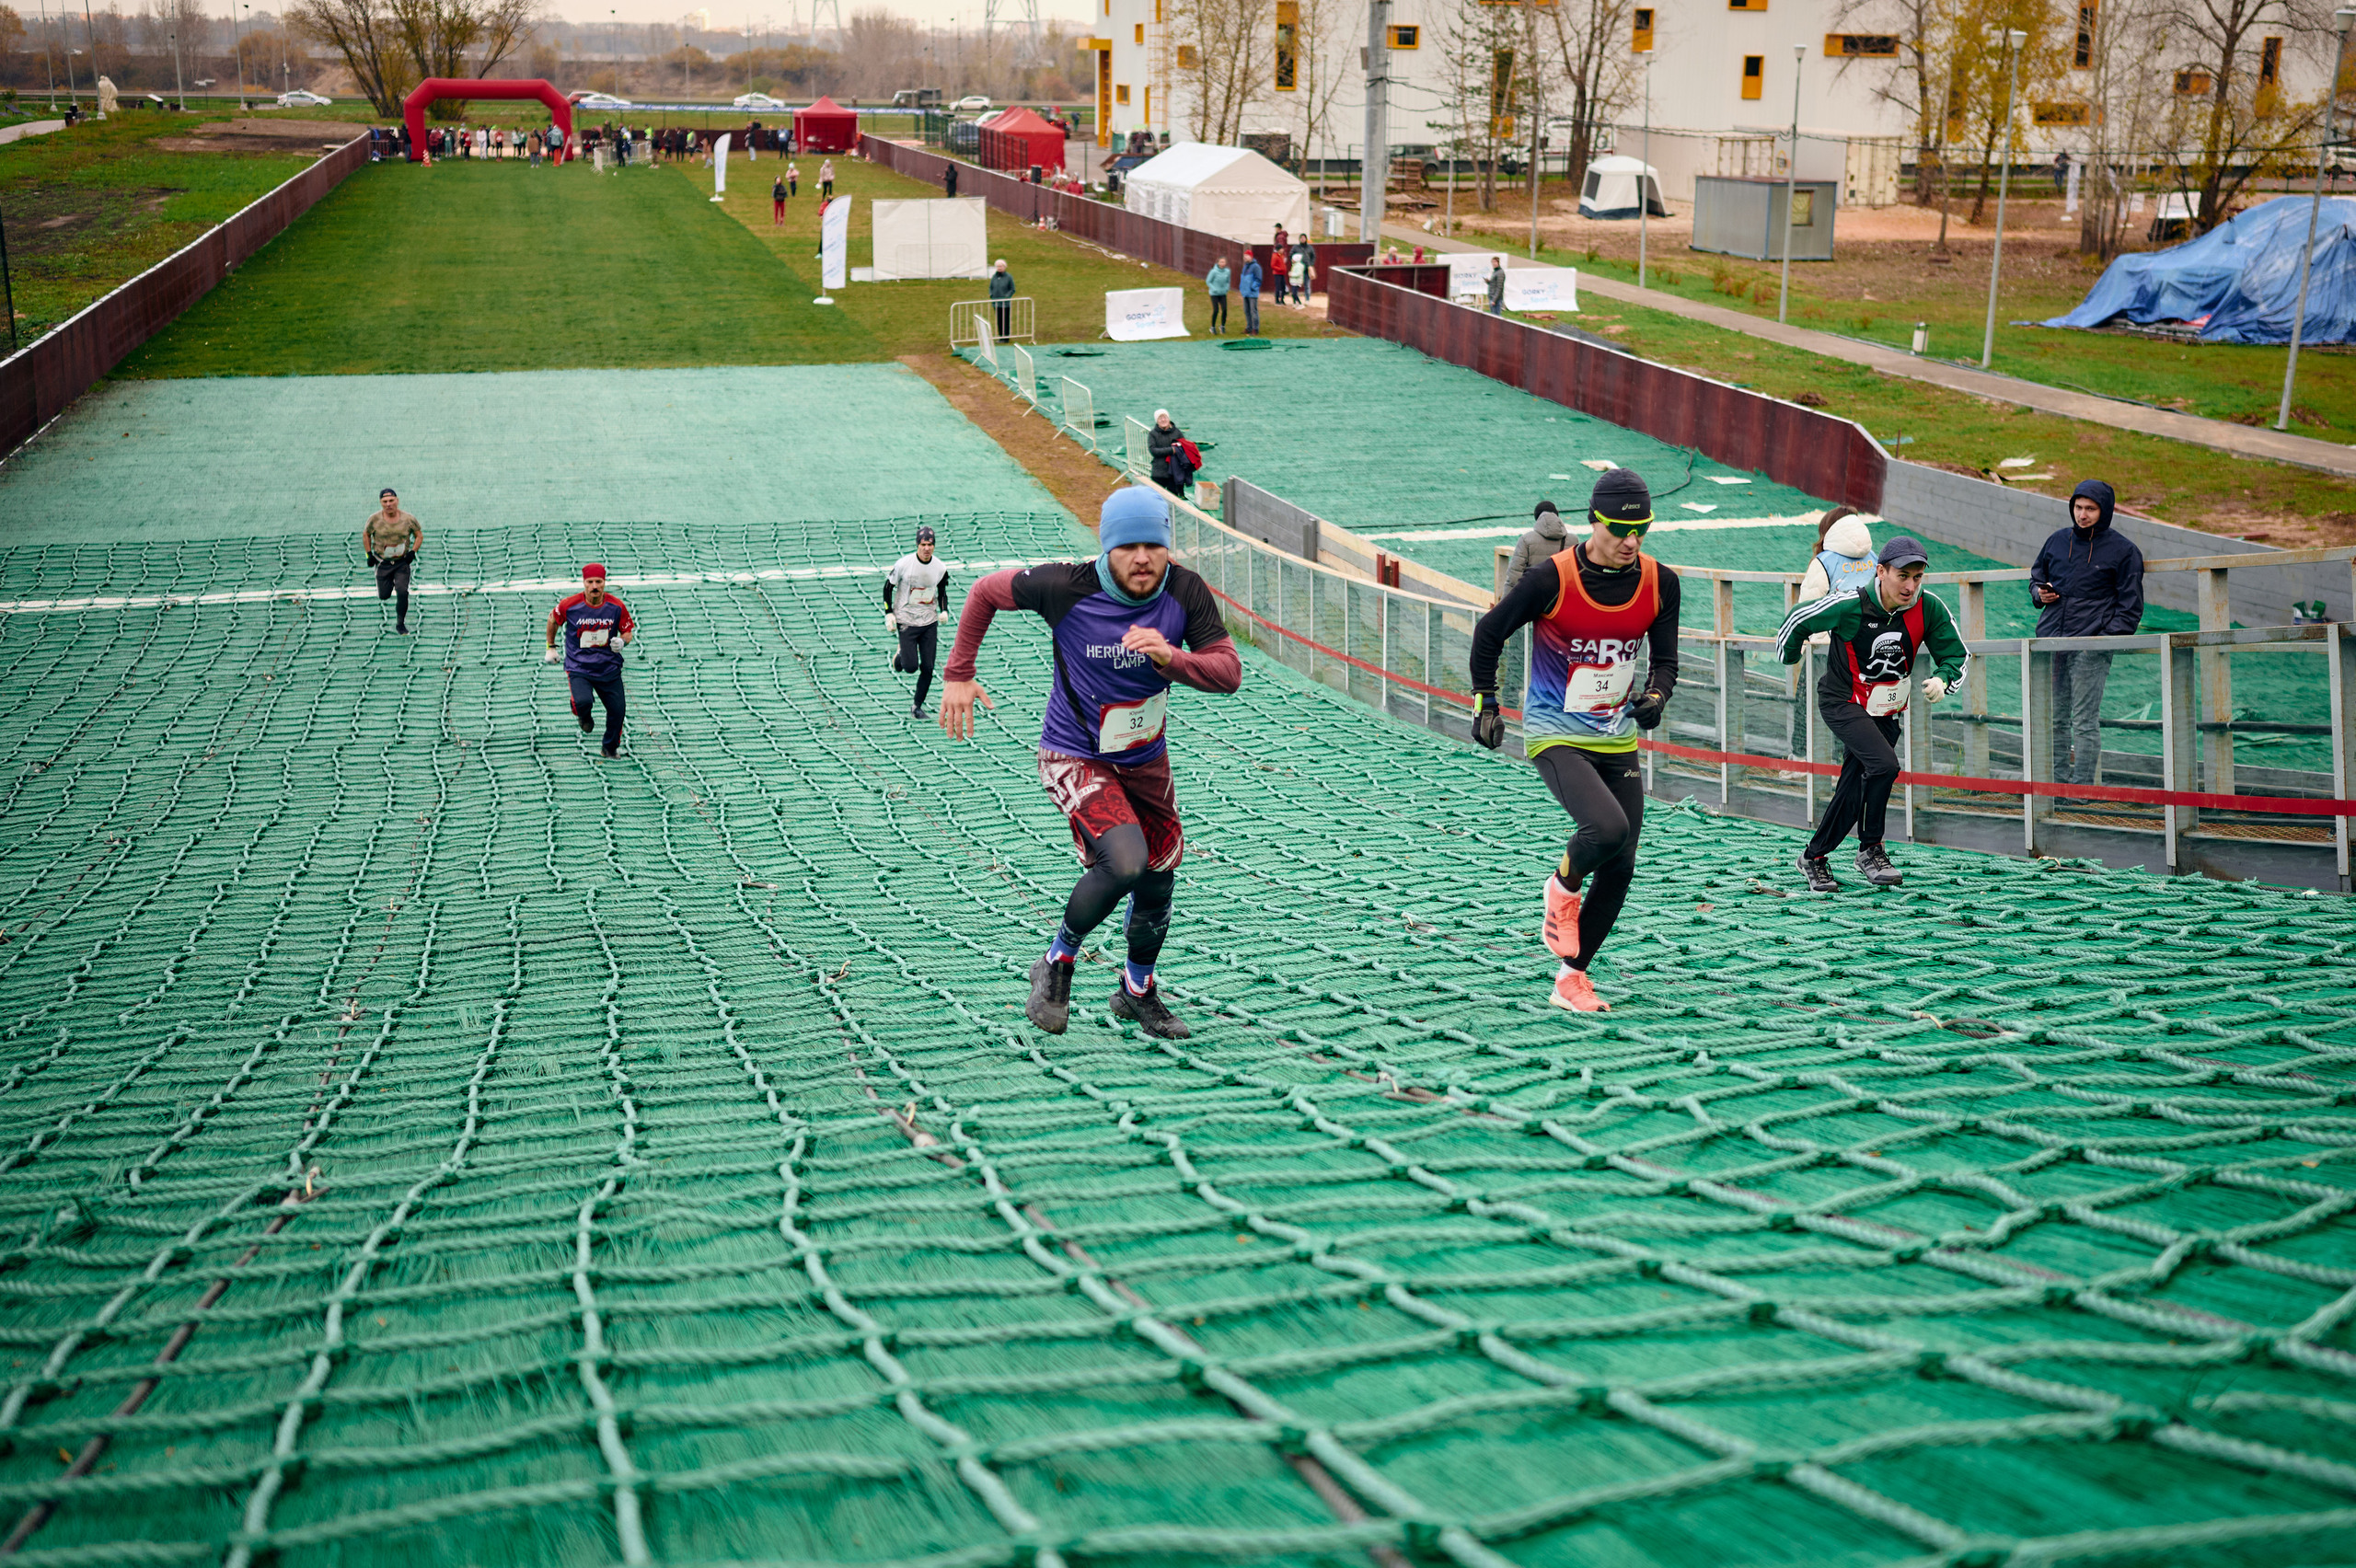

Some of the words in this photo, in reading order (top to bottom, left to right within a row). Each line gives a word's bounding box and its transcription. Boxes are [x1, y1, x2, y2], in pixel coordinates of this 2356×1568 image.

[1842, 559, 1875, 574] СУДЬЯ
[1114, 656, 1146, 669] CAMP
[1595, 680, 1609, 692] 34
[1888, 693, 1897, 701] 38
[1129, 717, 1143, 729] 32
